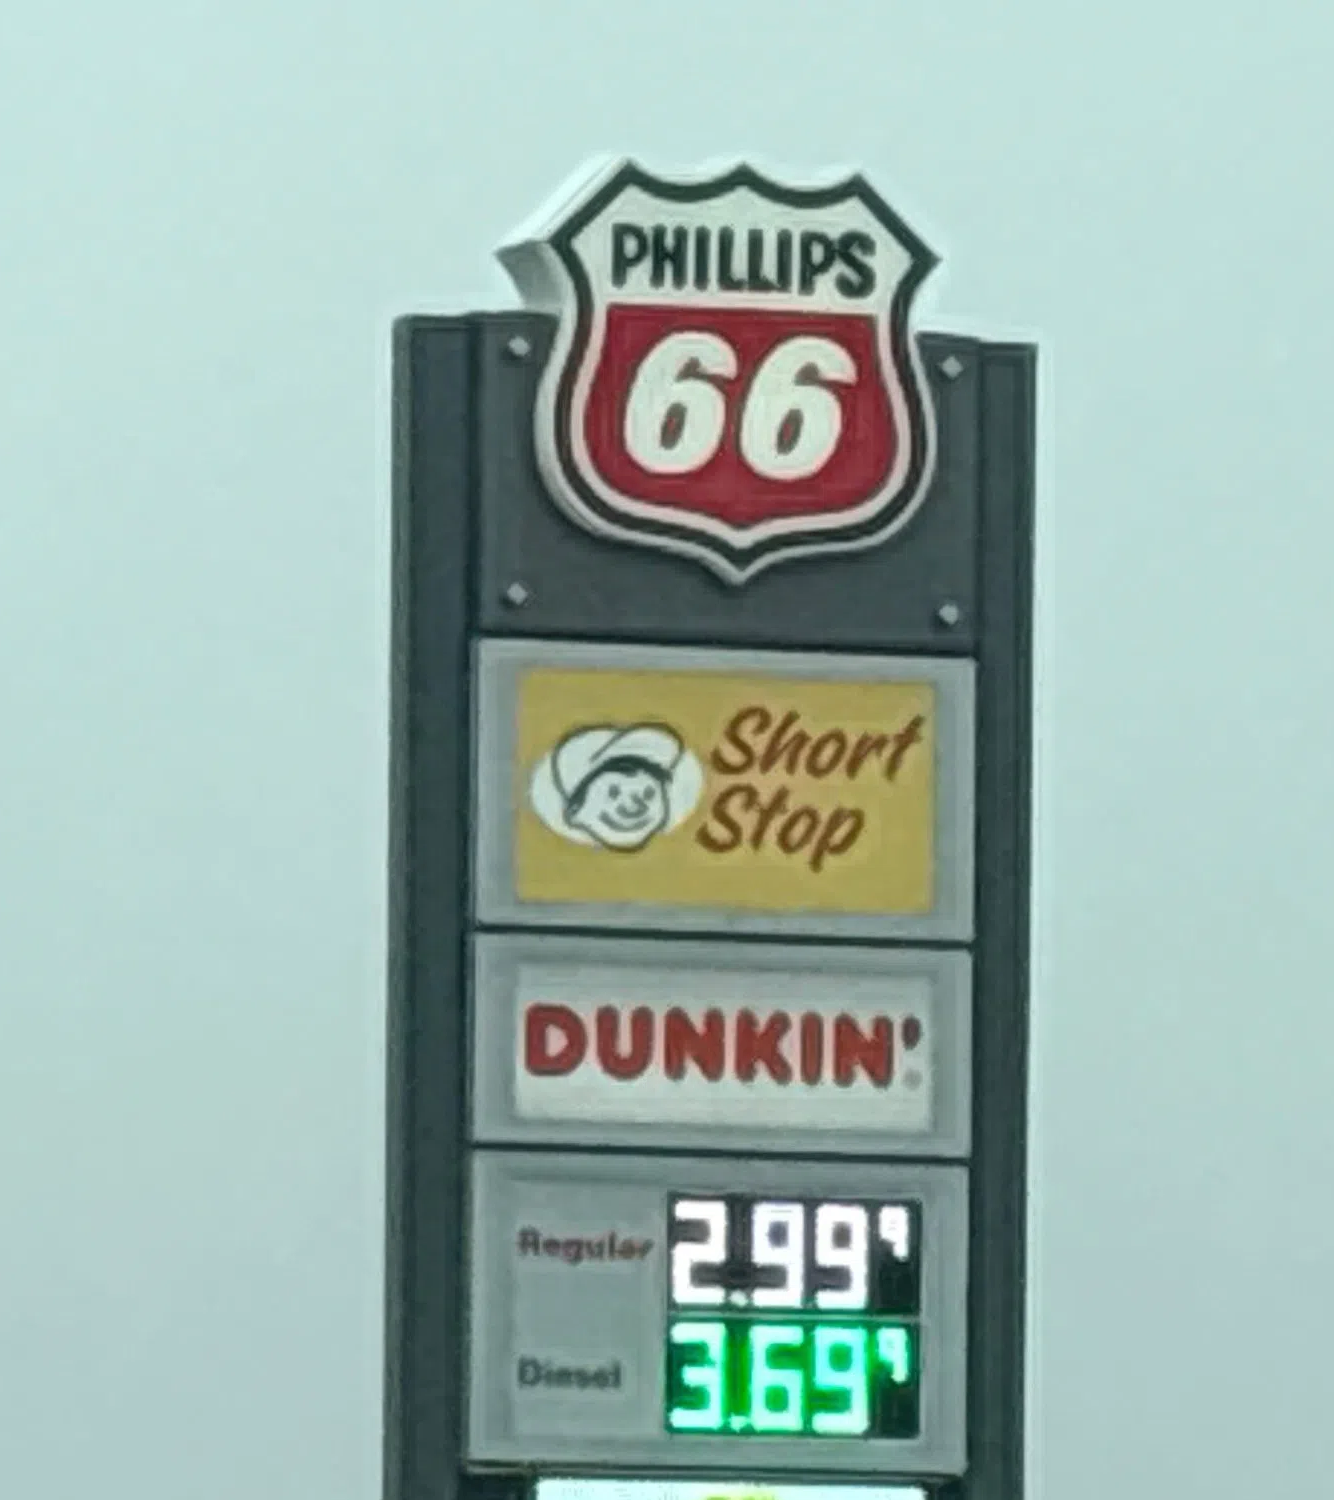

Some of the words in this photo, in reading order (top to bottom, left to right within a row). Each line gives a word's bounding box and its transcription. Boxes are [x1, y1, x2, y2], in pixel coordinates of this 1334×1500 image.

[610, 222, 877, 299] PHILLIPS
[622, 328, 858, 482] 66
[710, 705, 925, 782] Short
[695, 783, 866, 874] Stop
[524, 1001, 923, 1089] DUNKIN'
[517, 1225, 655, 1266] Regular
[517, 1355, 622, 1389] Diesel
